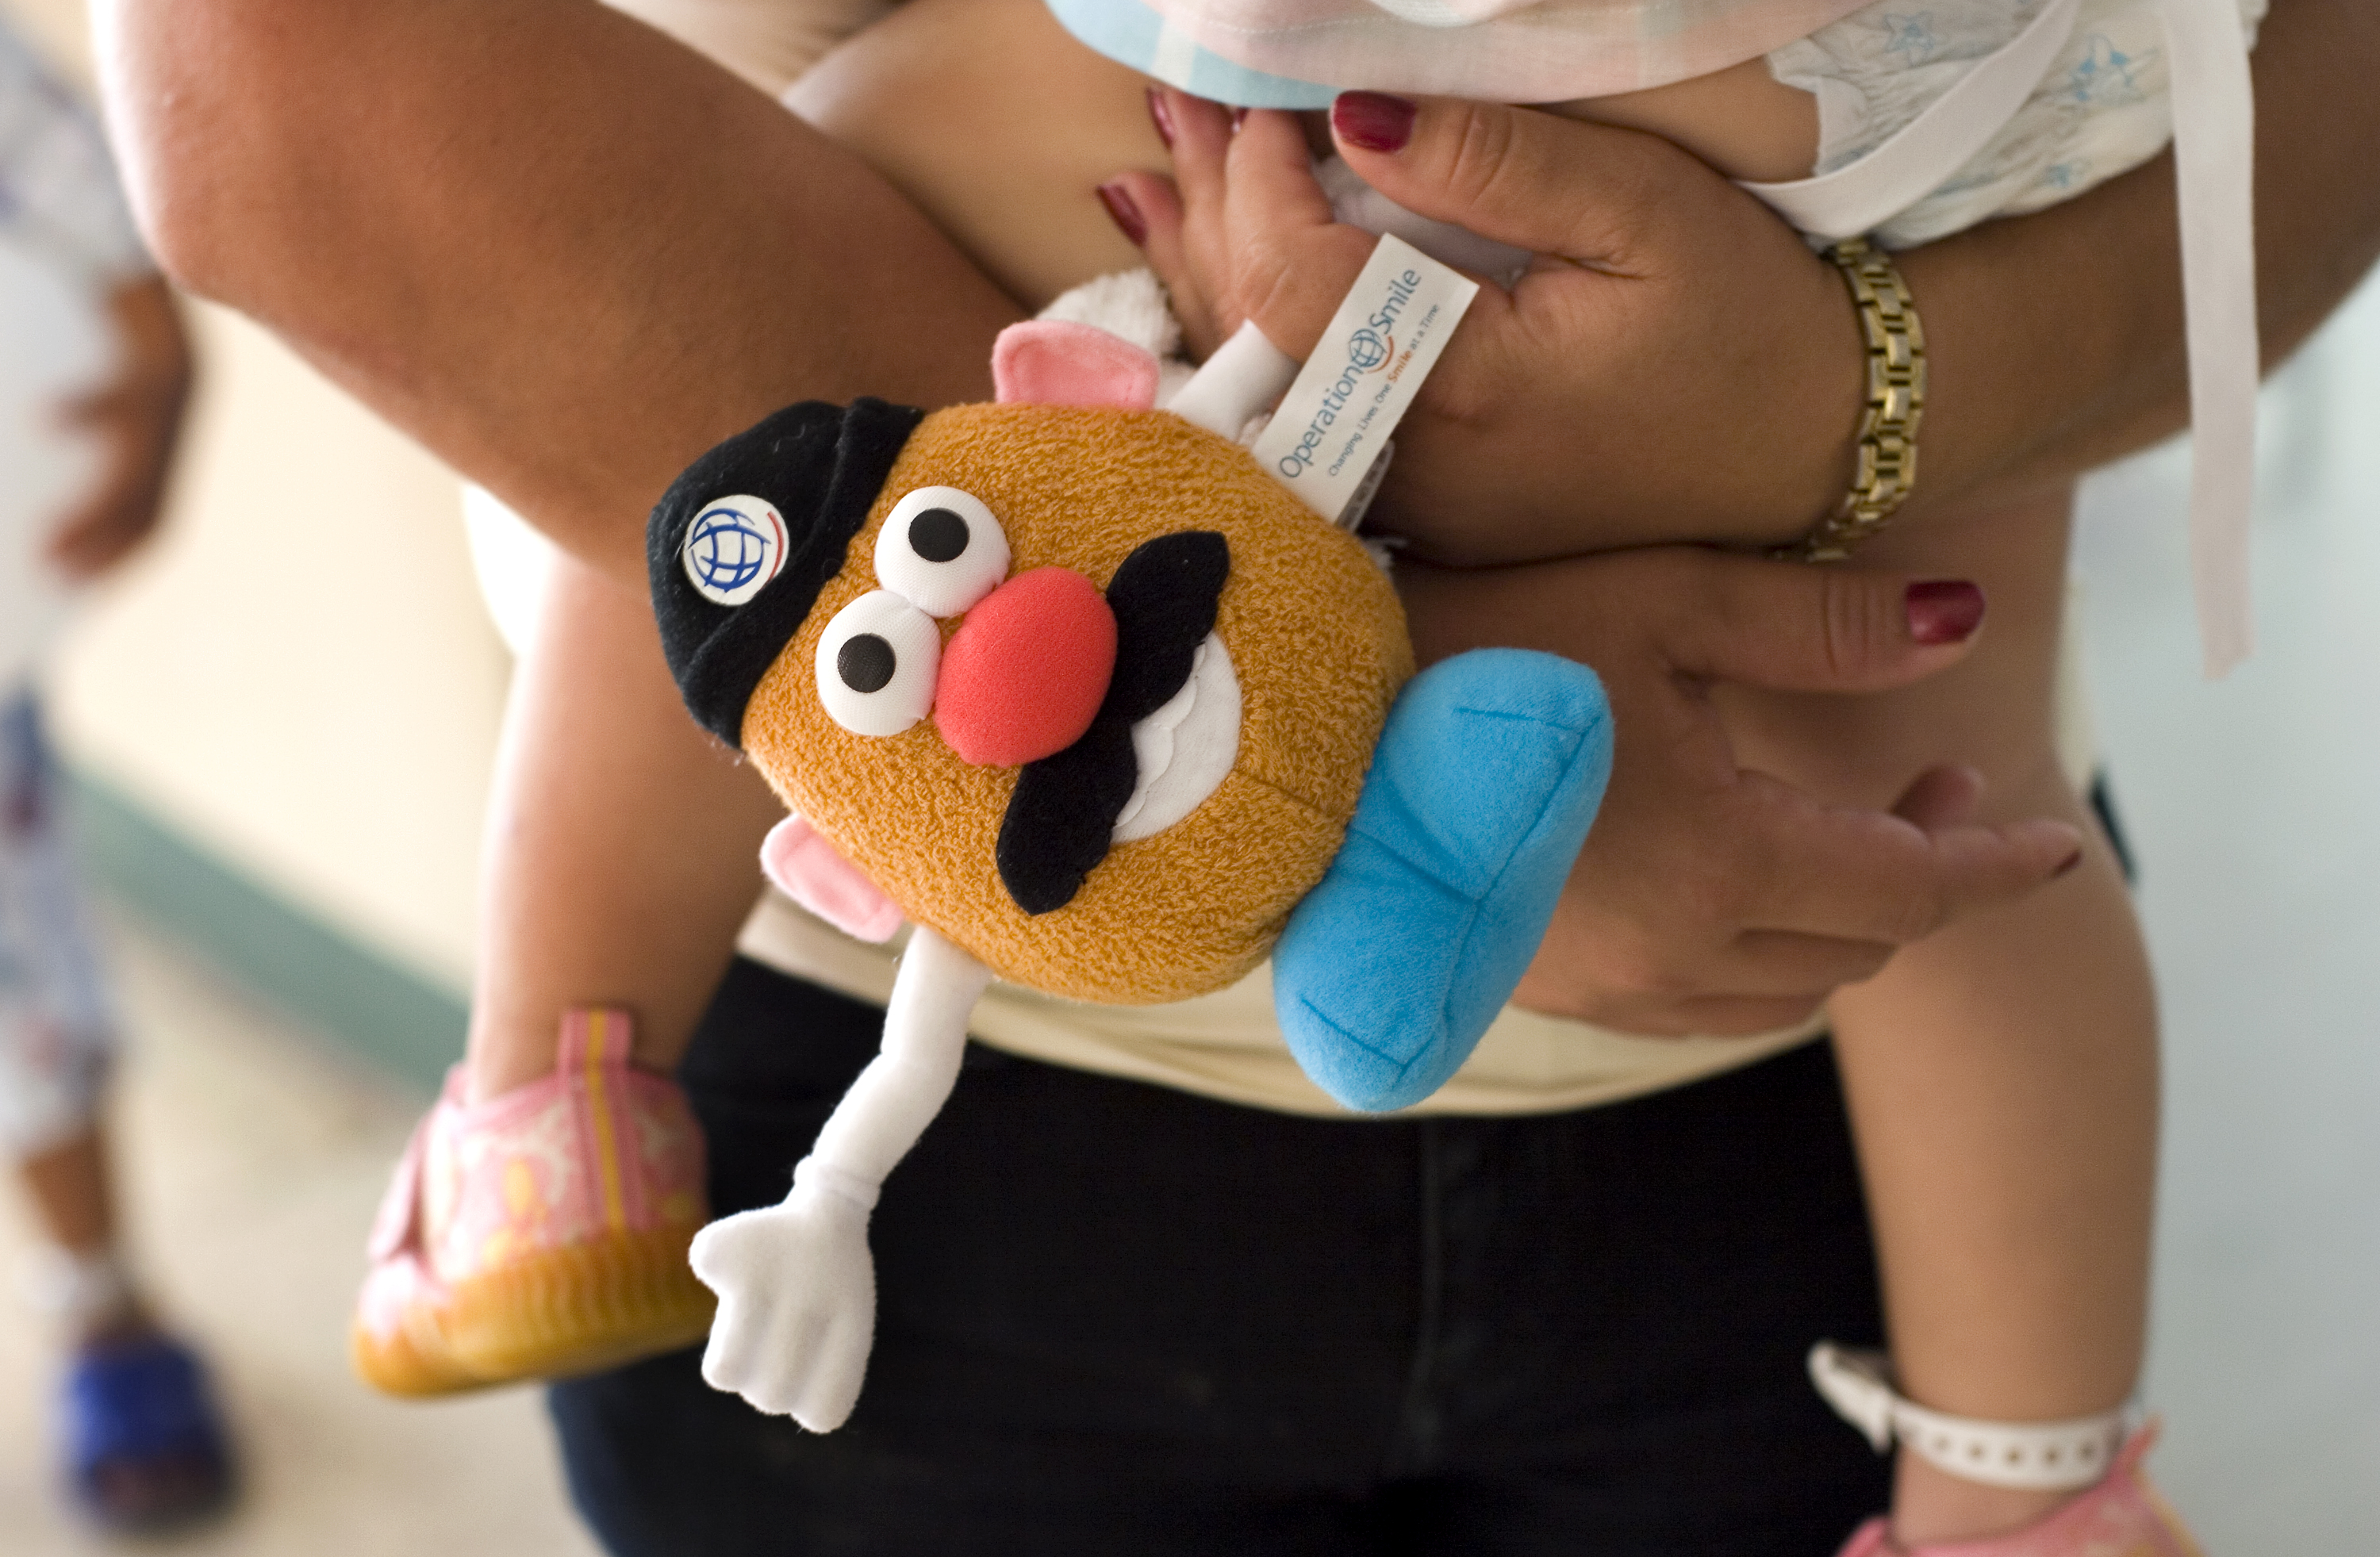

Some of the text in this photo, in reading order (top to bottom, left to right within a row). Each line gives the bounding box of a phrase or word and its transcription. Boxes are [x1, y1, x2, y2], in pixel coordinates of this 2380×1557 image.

[1419, 304, 1440, 328] Time
[1409, 338, 1420, 351] at
[1417, 329, 1426, 338] a
[1279, 269, 1422, 478] Operation Smile
[1387, 350, 1413, 383] Smile
[1375, 383, 1392, 404] One
[1357, 405, 1379, 430] Lives
[1328, 432, 1364, 477] Changing
